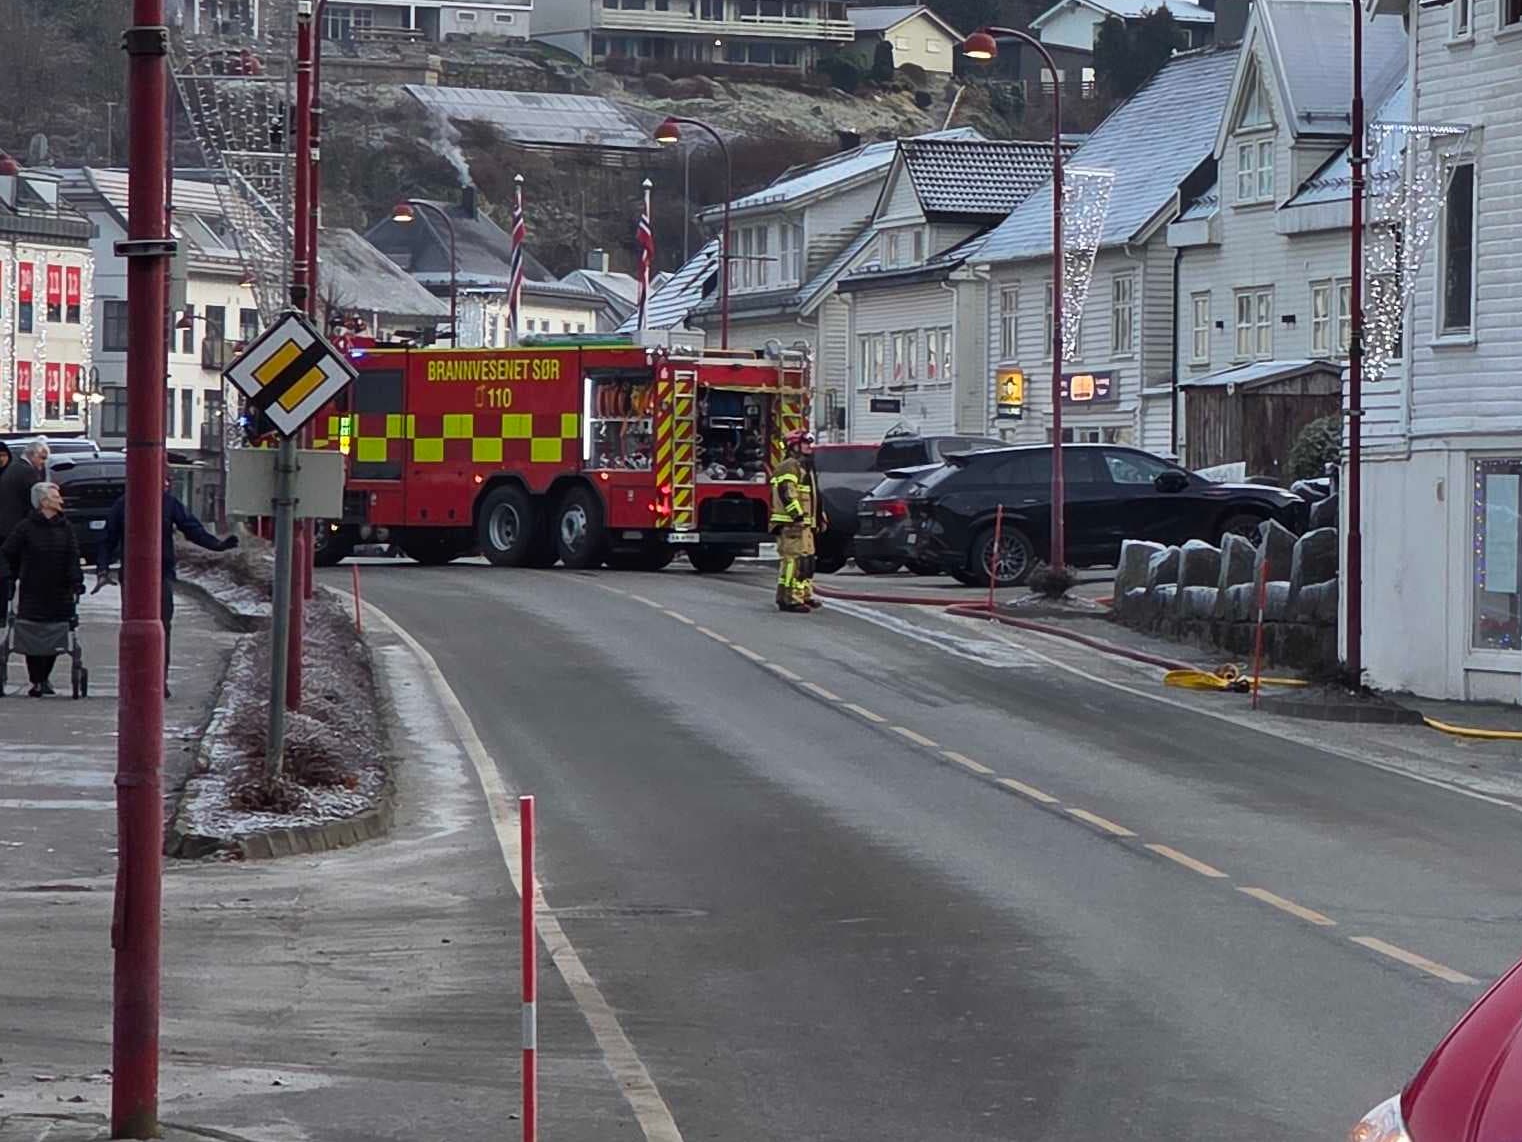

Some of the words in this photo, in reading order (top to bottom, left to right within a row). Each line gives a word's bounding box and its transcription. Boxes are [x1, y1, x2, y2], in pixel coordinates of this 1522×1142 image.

[428, 359, 530, 380] BRANNVESENET
[532, 358, 560, 380] SØR
[487, 387, 512, 408] 110
